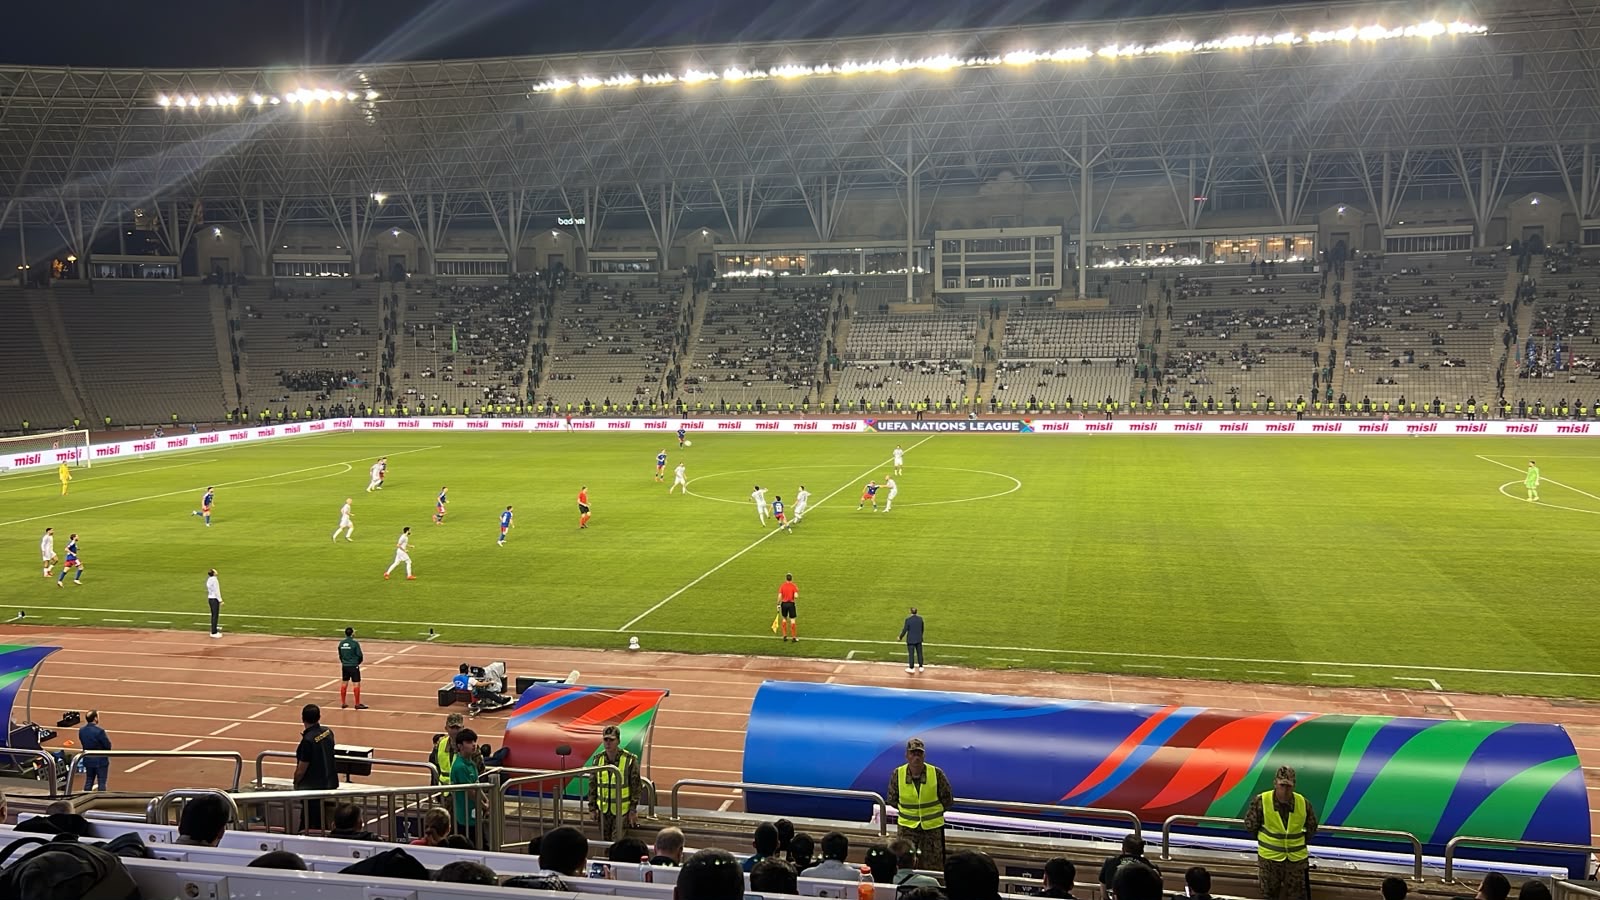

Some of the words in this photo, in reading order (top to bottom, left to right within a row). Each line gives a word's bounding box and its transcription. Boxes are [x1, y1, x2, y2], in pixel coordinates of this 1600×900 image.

[432, 420, 454, 428] misli
[467, 420, 489, 428] misli
[608, 421, 631, 429] misli
[644, 421, 667, 429] misli
[680, 421, 704, 429] misli
[718, 421, 741, 429] misli
[756, 421, 779, 429] misli
[794, 422, 817, 430] misli
[832, 422, 856, 430] misli
[877, 422, 908, 430] UEFA
[911, 422, 966, 431] NATIONS
[969, 422, 1020, 431] LEAGUE
[1042, 423, 1069, 431] misli
[1085, 423, 1113, 431] misli
[1130, 423, 1157, 431] misli
[1175, 423, 1203, 431] misli
[1220, 423, 1249, 431] misli
[1266, 423, 1295, 431] misli
[1312, 423, 1342, 432] misli
[1359, 423, 1389, 432] misli
[1407, 423, 1437, 432] misli
[1456, 423, 1487, 432] misli
[1506, 423, 1537, 432] misli
[1557, 423, 1589, 432] misli
[14, 454, 41, 466] misli
[96, 445, 120, 456] misli
[133, 441, 156, 452] misli
[168, 438, 188, 448] misli
[199, 434, 219, 444] misli
[229, 431, 248, 440] misli
[258, 428, 275, 437] misli
[333, 420, 352, 428] misli
